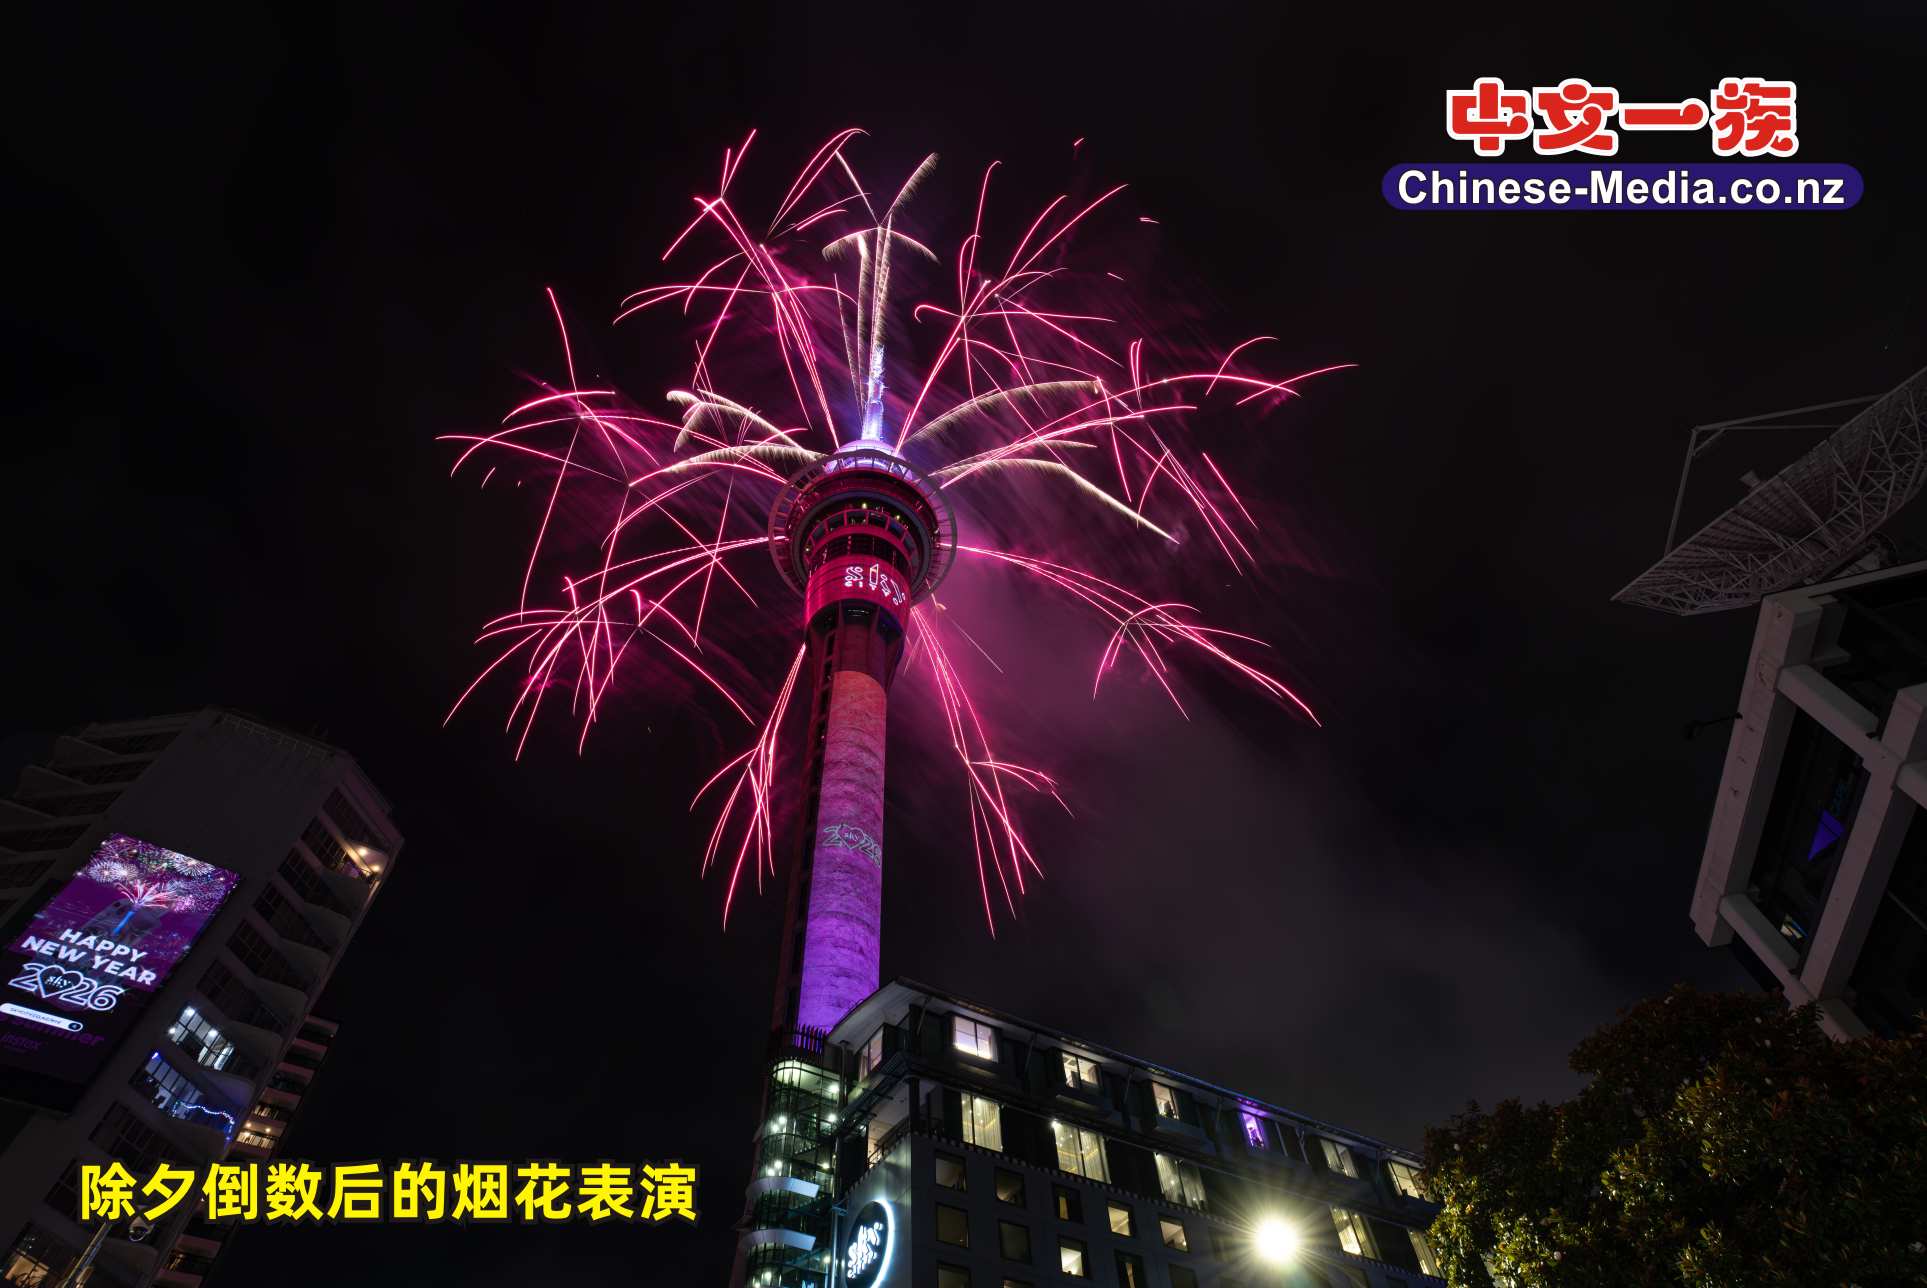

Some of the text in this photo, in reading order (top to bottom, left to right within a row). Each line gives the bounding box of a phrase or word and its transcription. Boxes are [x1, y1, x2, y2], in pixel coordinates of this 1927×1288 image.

[21, 935, 157, 986] NEW YEAR
[59, 928, 148, 962] HAPPY
